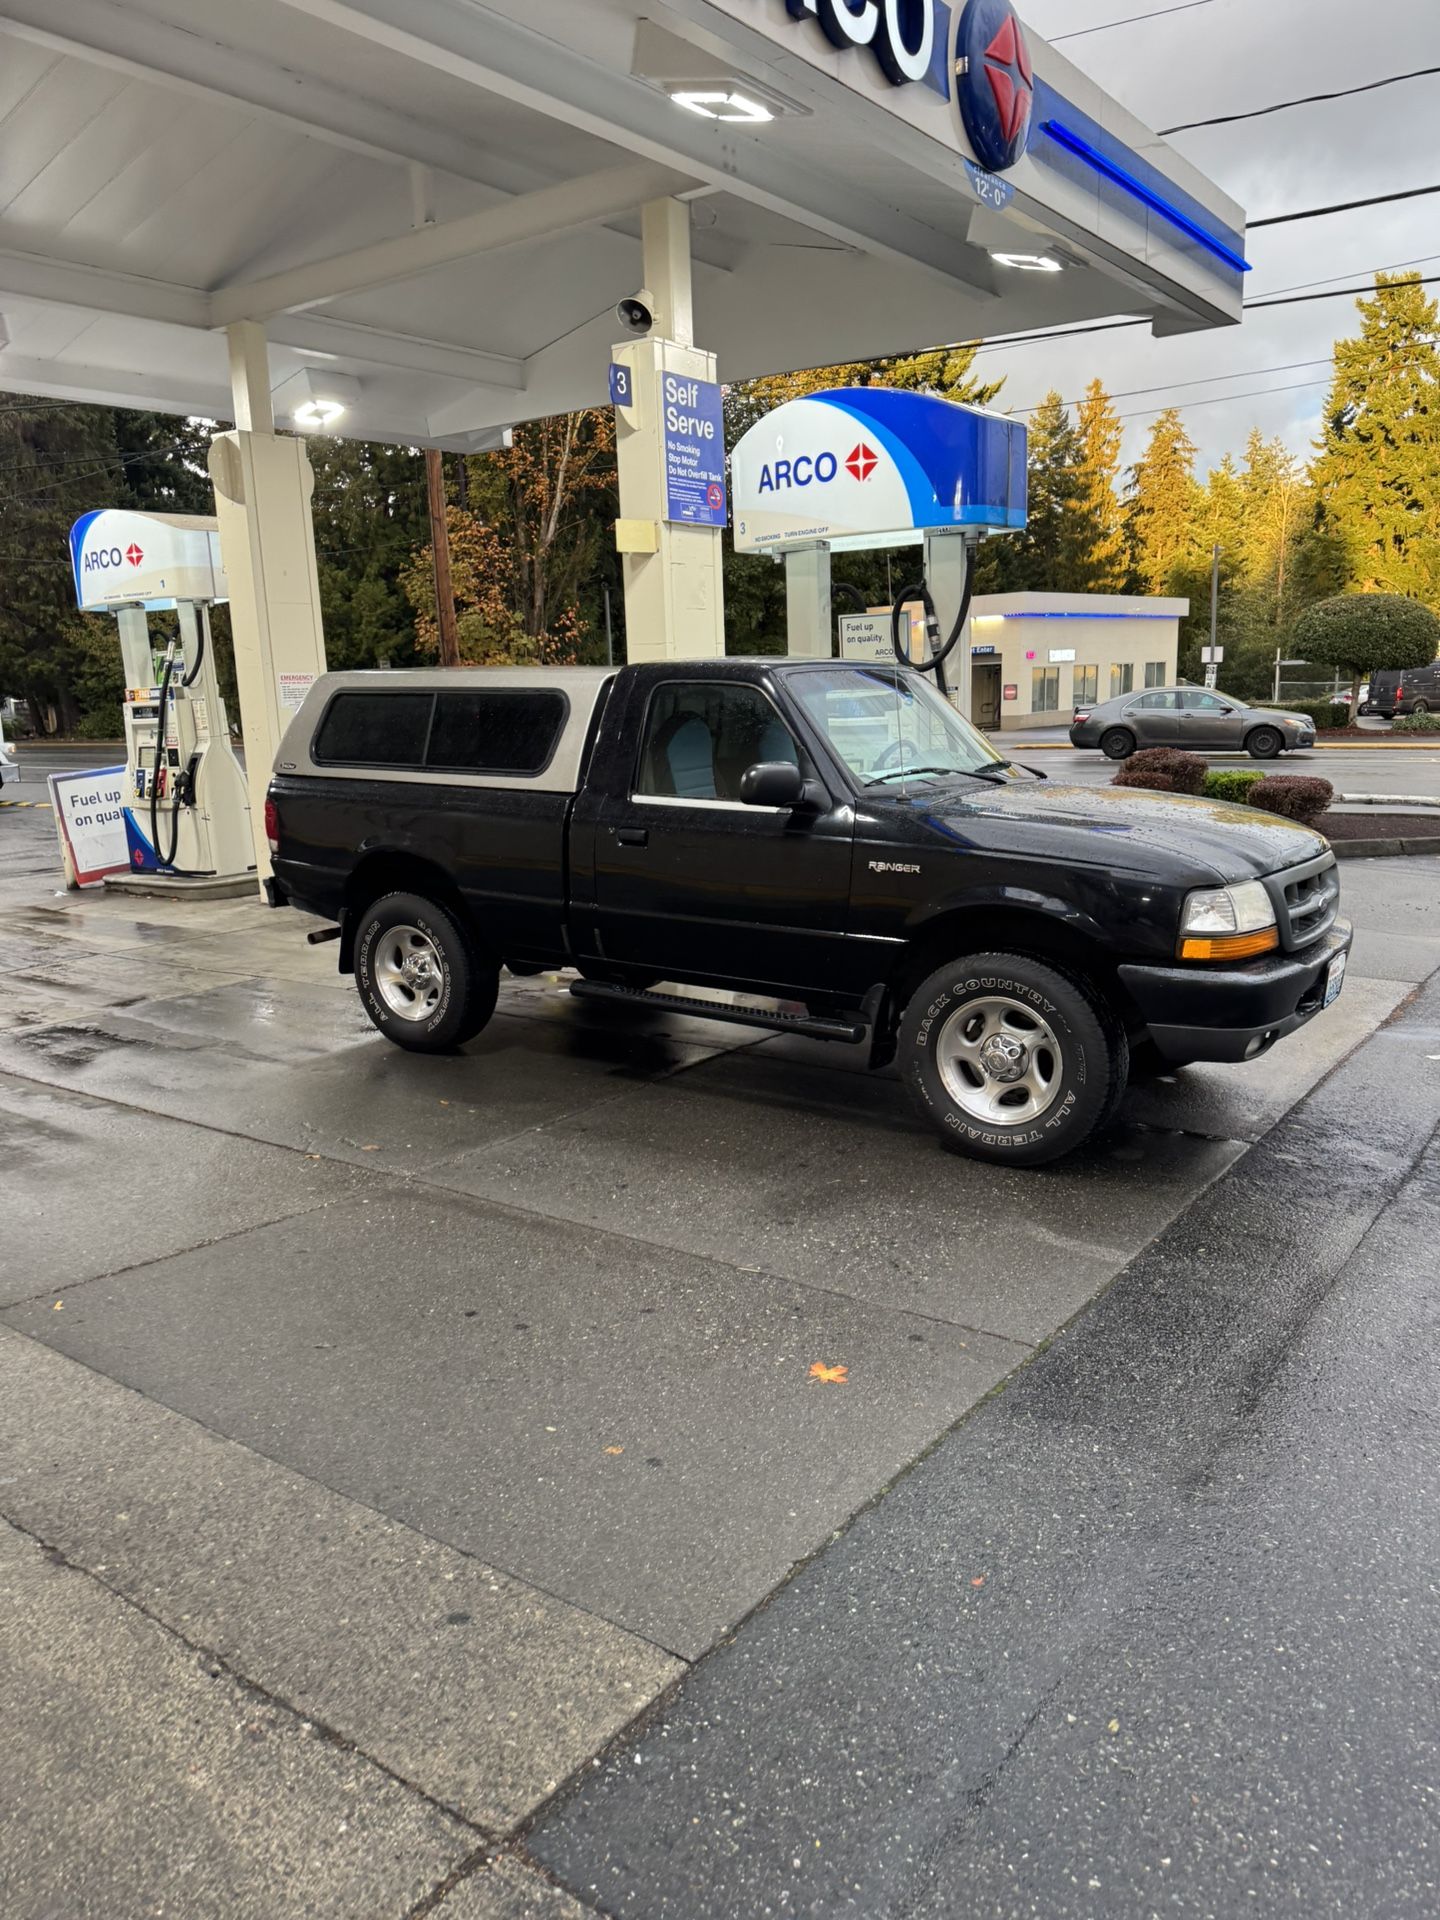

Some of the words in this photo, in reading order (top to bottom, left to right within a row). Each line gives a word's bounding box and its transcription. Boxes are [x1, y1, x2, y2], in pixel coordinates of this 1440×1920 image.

[617, 372, 626, 394] 3
[665, 377, 699, 408] Self
[666, 406, 715, 440] Serve
[668, 441, 675, 451] No
[676, 442, 701, 457] Smoking
[667, 453, 681, 466] Stop
[681, 456, 699, 467] Motor
[668, 465, 677, 475] Do
[677, 467, 688, 478] Not
[708, 471, 722, 483] Tank
[758, 451, 838, 494] ARCO
[740, 522, 746, 534] 3
[84, 547, 122, 572] ARCO
[160, 579, 166, 589] 1
[846, 622, 863, 631] Fuel
[864, 624, 873, 632] up
[847, 635, 856, 643] on
[857, 633, 884, 644] quality.
[875, 648, 893, 656] ARCO
[70, 791, 102, 808] Fuel
[105, 790, 121, 804] up
[75, 815, 92, 827] on
[868, 860, 921, 873] RANGER
[417, 919, 446, 957] BACK
[360, 920, 381, 989] TERRAIN
[369, 992, 389, 1022] ALL
[916, 993, 951, 1046] BACK
[953, 977, 1057, 1013] COUNTRY
[1045, 1089, 1076, 1128] ALL
[944, 1112, 1043, 1146] TERRAIN
